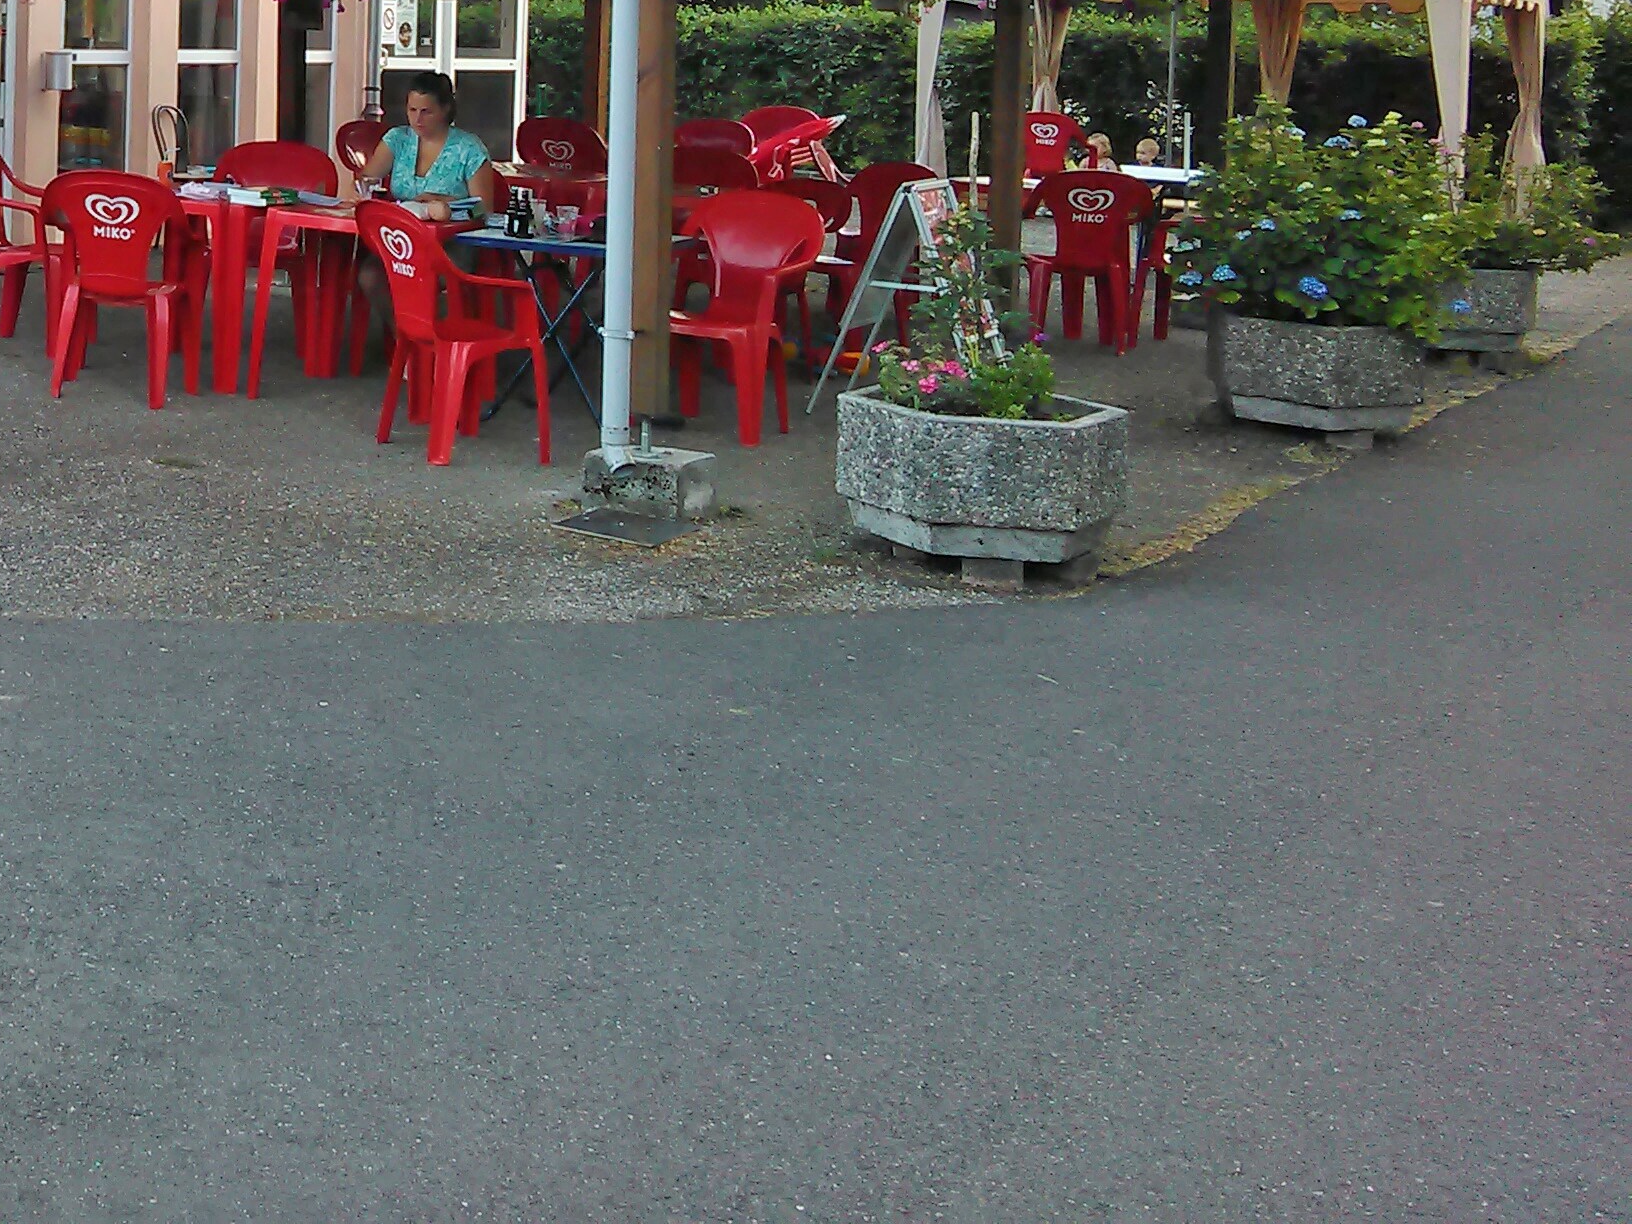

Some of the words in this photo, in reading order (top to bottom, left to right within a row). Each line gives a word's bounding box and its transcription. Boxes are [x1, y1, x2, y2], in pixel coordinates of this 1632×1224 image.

[1036, 138, 1056, 146] MIKO
[1072, 213, 1105, 224] MIKO
[93, 224, 131, 240] MIKO
[391, 260, 414, 278] MIKO
